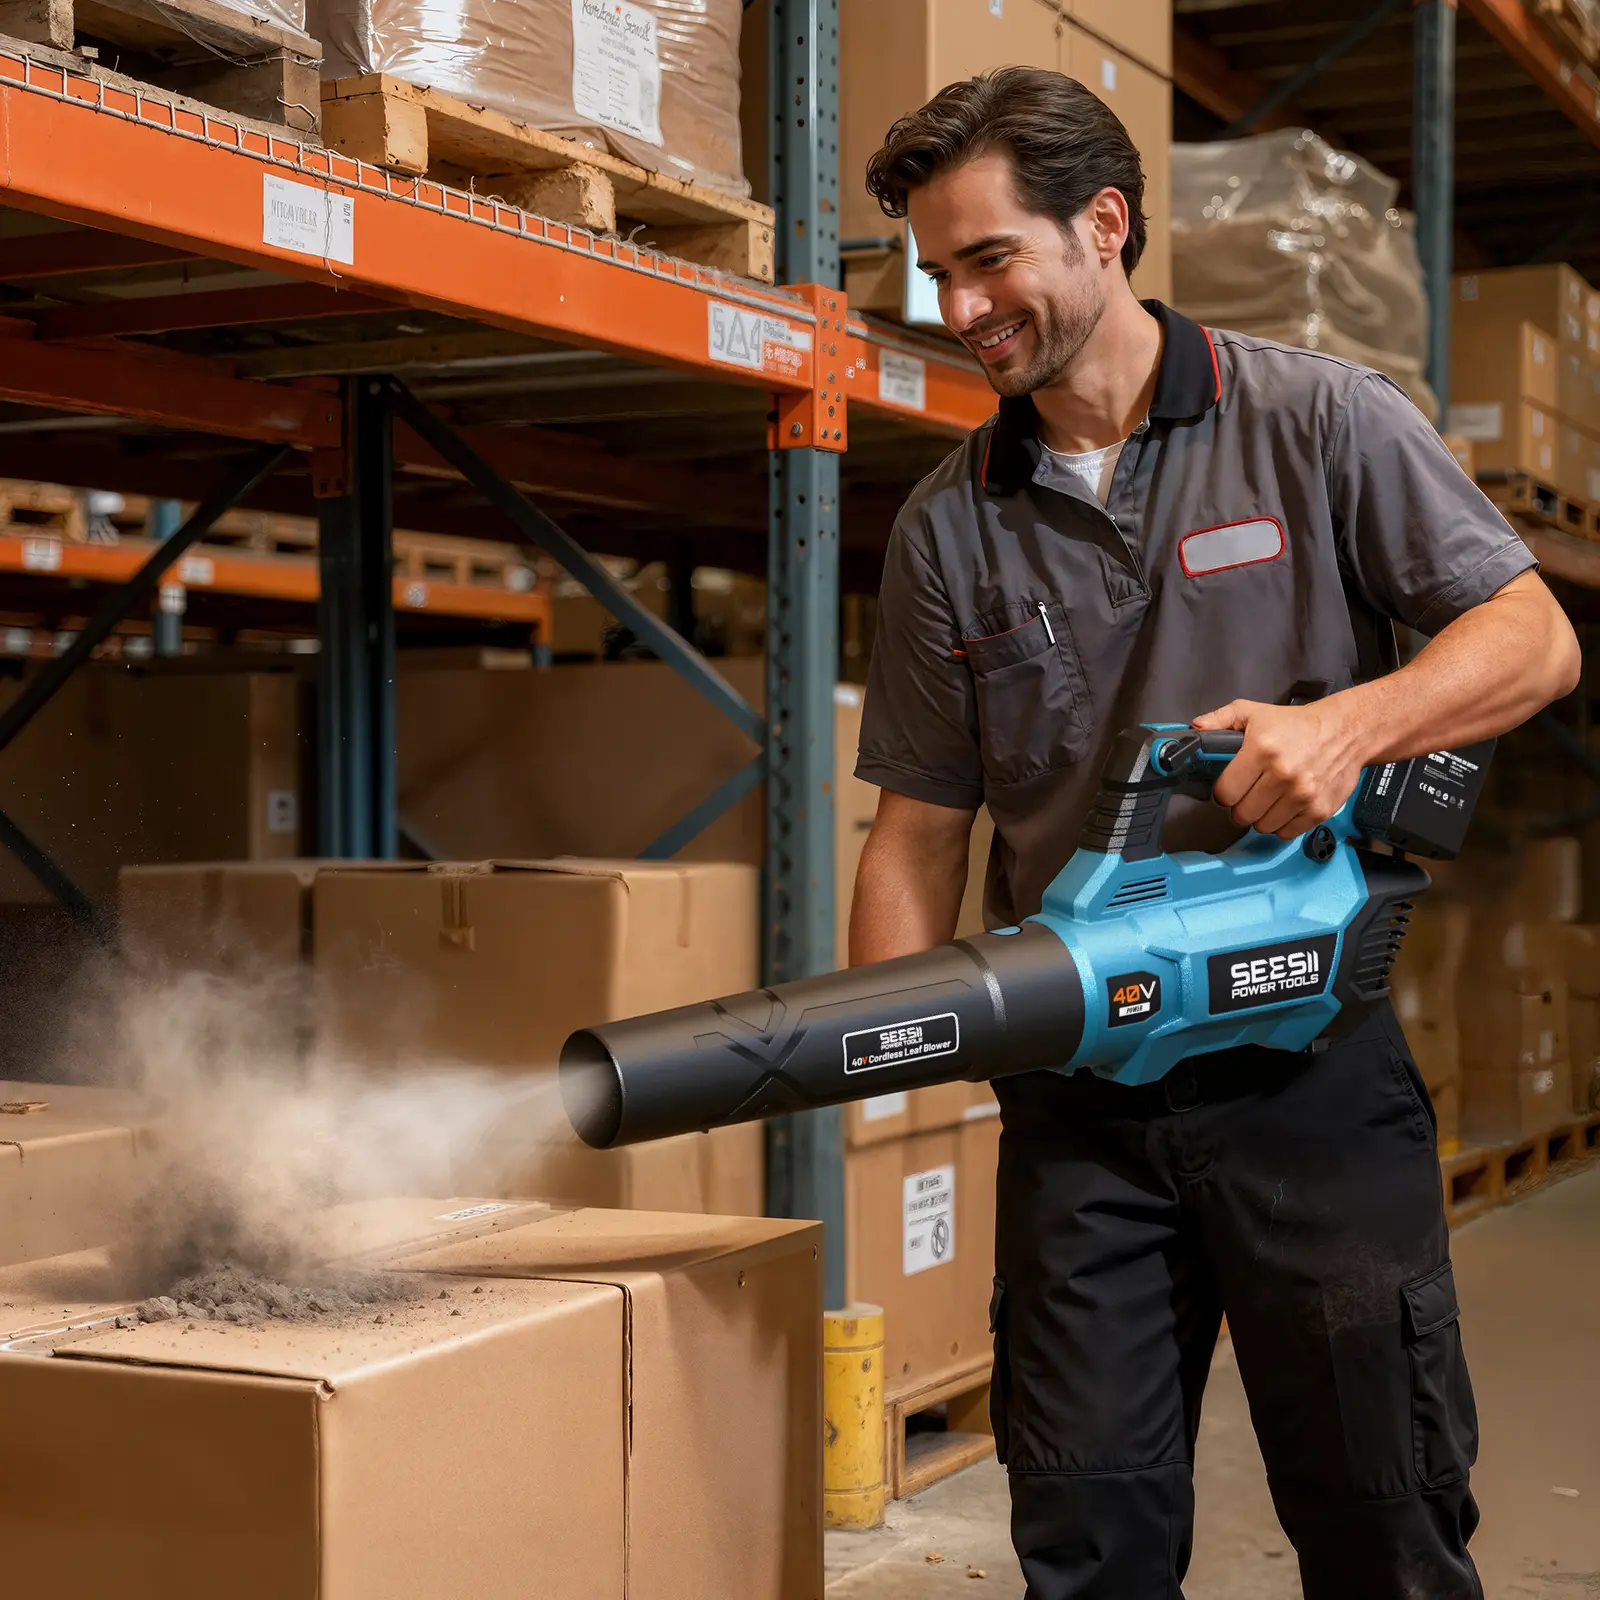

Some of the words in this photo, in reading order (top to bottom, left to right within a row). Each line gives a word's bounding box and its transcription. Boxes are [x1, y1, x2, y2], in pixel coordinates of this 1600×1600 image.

[1112, 980, 1157, 1004] 40V
[1231, 979, 1276, 1000] POWER
[1279, 973, 1319, 991] TOOLS
[1126, 1004, 1143, 1014] POWER
[851, 1055, 868, 1067] 40V
[868, 1049, 904, 1064] Cordless
[904, 1044, 923, 1057] Leaf
[923, 1040, 952, 1053] Blower
[880, 1041, 903, 1051] POWER
[903, 1037, 923, 1046] TOOLS
